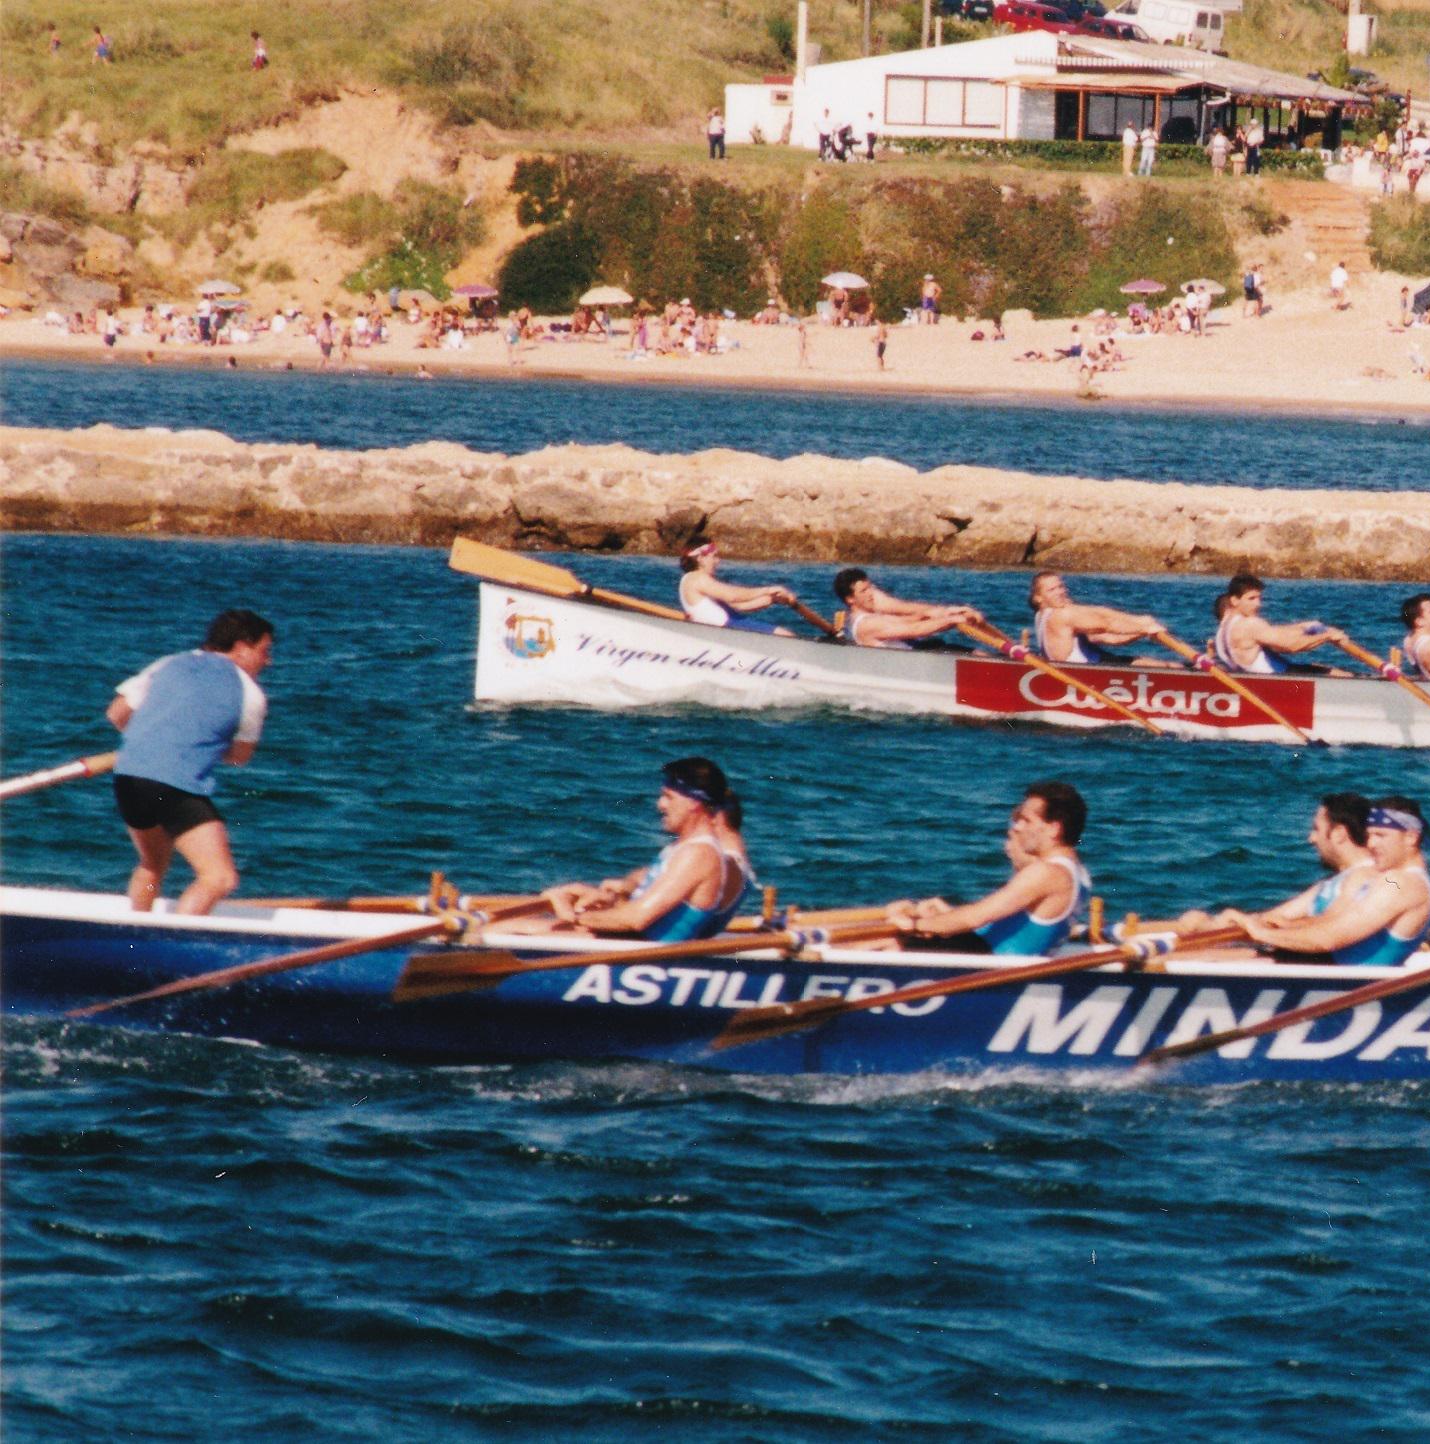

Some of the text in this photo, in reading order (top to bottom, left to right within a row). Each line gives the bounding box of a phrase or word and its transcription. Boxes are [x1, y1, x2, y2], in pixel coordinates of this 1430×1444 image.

[576, 632, 801, 680] Virgen del Mar
[562, 964, 948, 1017] ASTILLERO
